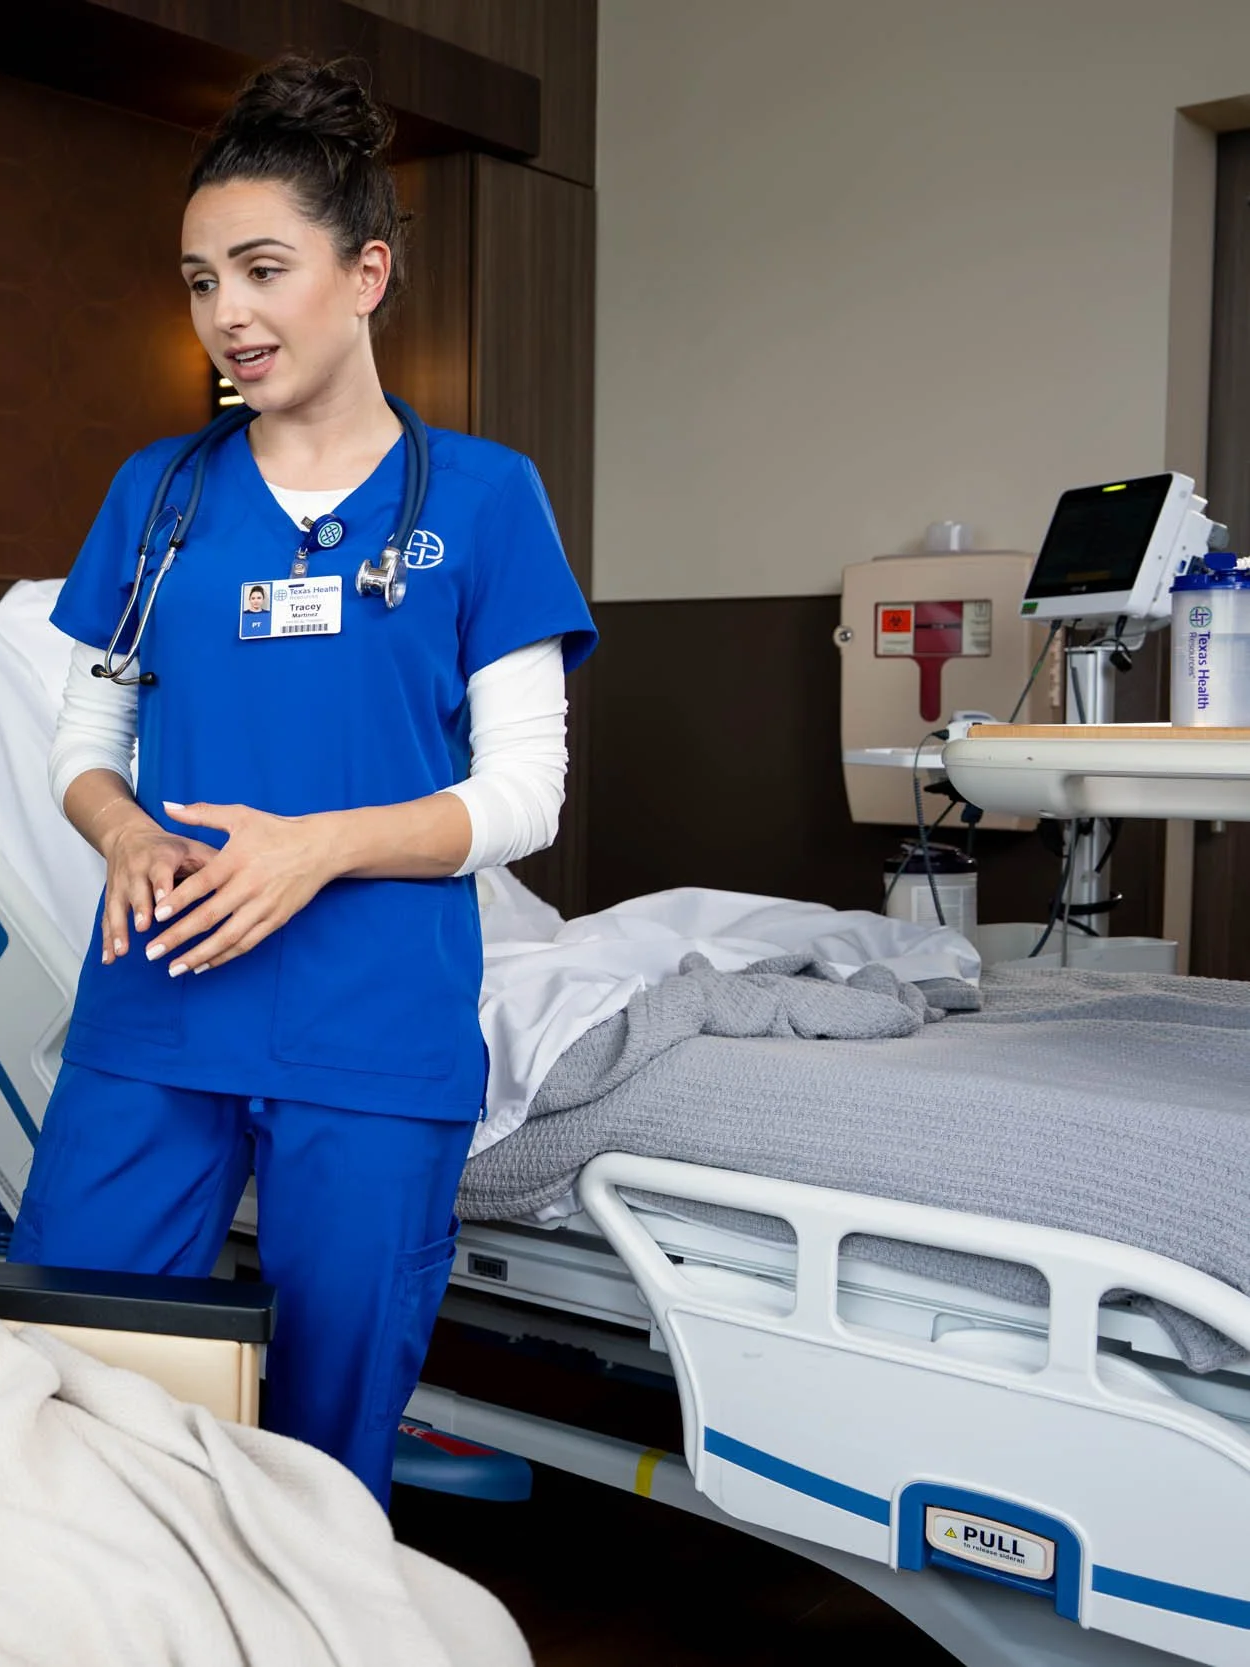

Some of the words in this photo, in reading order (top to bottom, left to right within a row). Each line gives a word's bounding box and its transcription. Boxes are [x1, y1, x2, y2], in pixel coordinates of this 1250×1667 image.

[290, 588, 311, 596] Texas
[313, 586, 339, 594] Health
[290, 603, 322, 611] Tracey
[1197, 631, 1211, 666] Texas
[1197, 669, 1210, 710] Health
[963, 1541, 971, 1549] to
[972, 1544, 998, 1556] release
[999, 1552, 1025, 1564] siderail
[964, 1526, 1025, 1557] PULL
